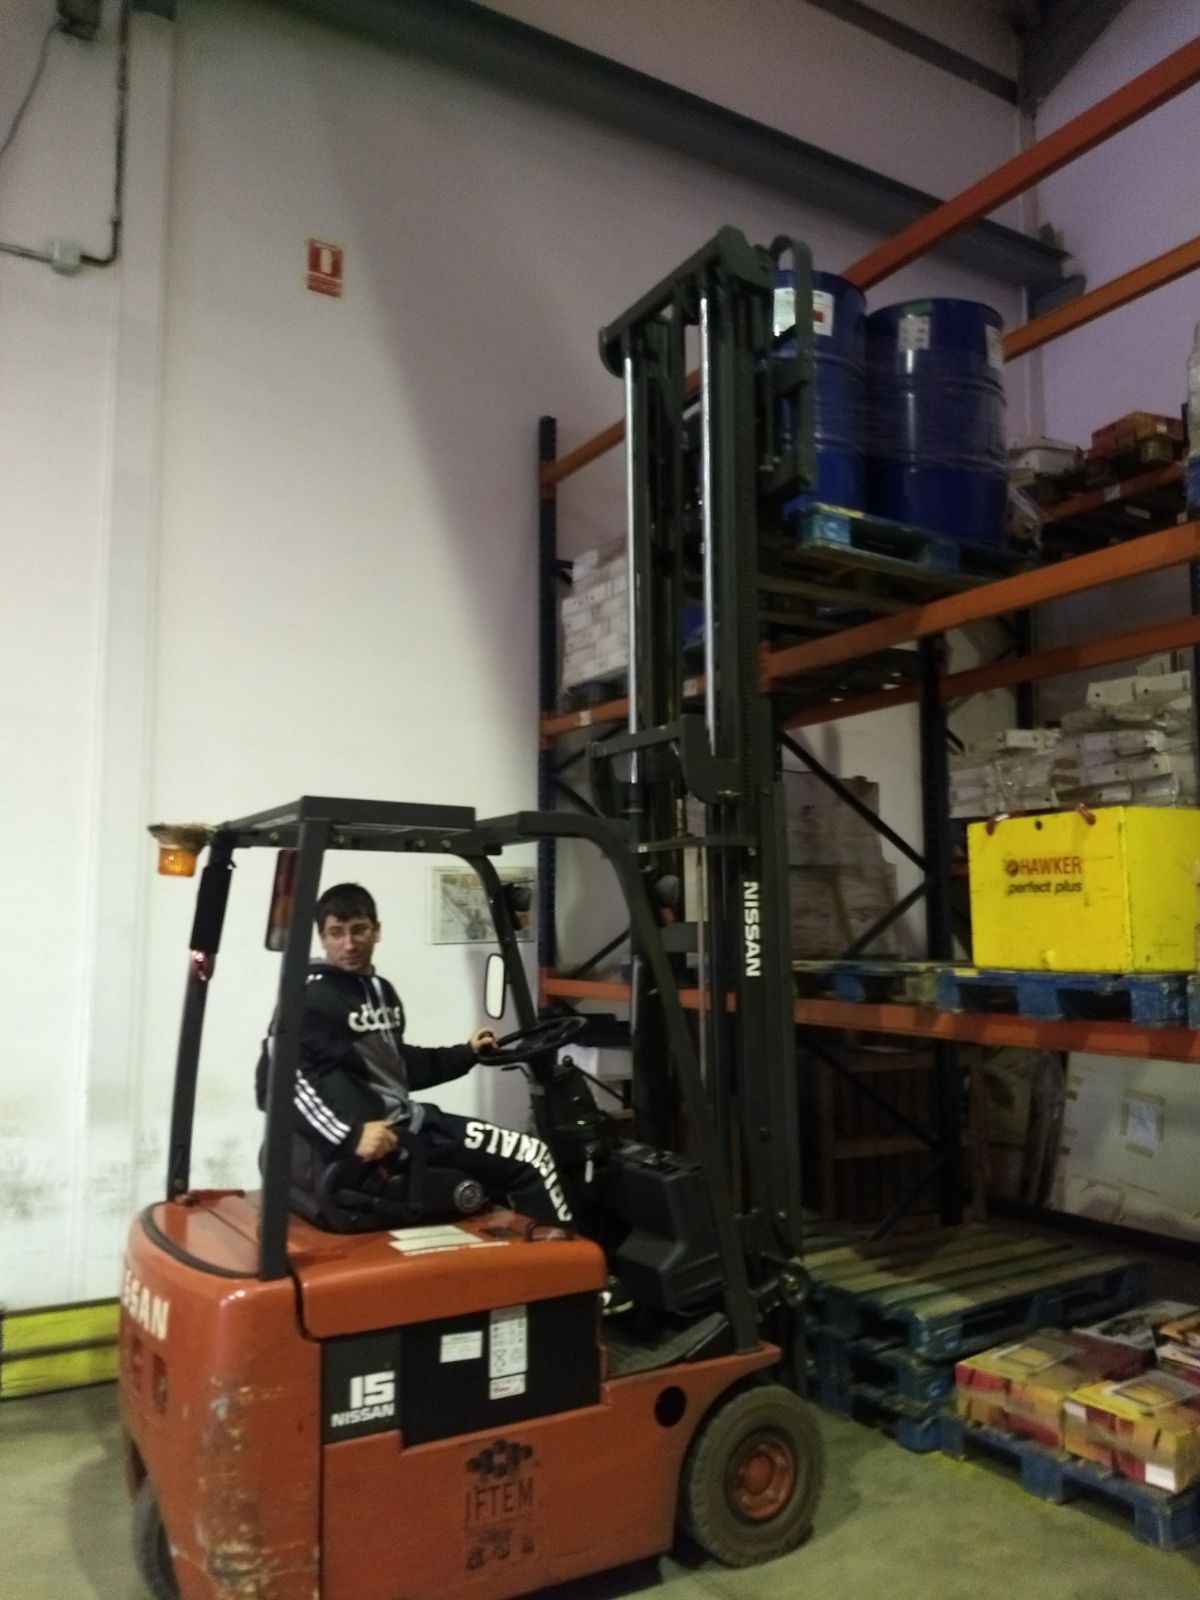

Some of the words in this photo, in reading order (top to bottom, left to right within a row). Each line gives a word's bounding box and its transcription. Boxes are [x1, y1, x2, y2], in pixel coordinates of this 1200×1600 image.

[1020, 856, 1082, 875] HAWKER
[1007, 882, 1051, 896] perfect
[1054, 881, 1082, 895] plus
[743, 881, 761, 977] NISSAN
[350, 1370, 395, 1409] 15
[331, 1402, 395, 1428] NISSAN
